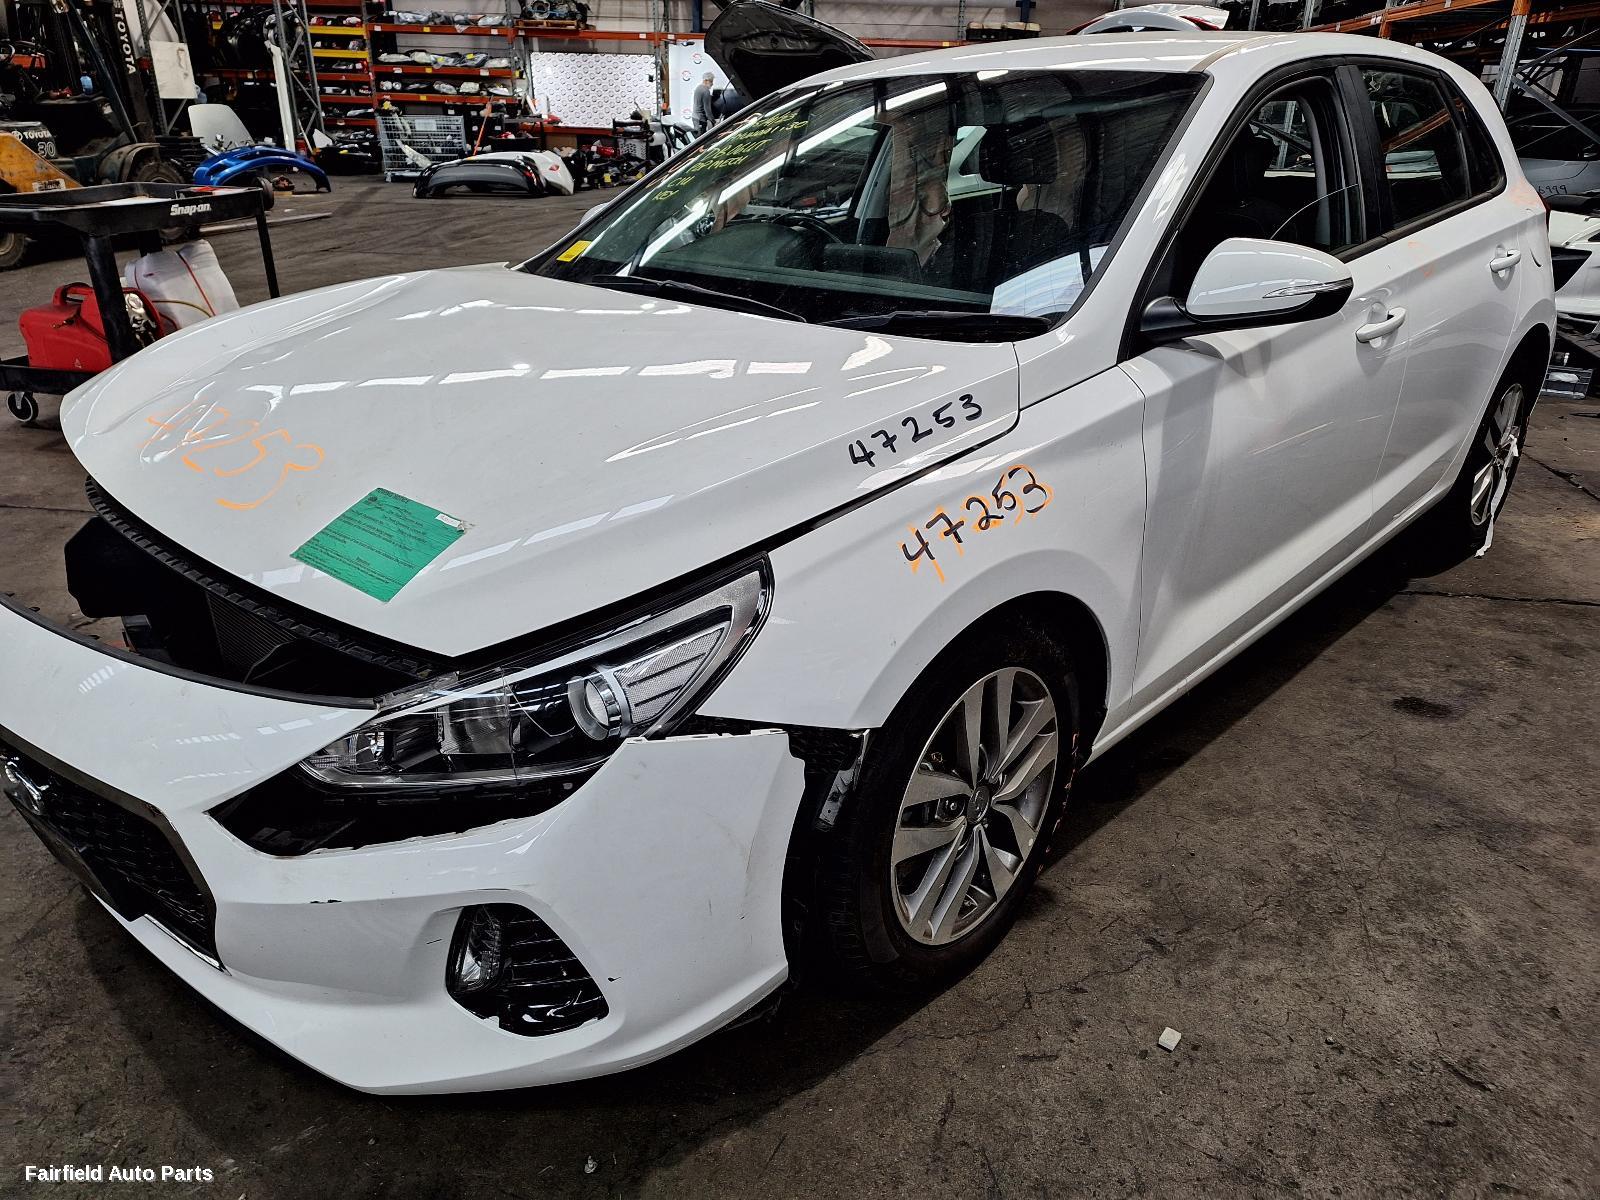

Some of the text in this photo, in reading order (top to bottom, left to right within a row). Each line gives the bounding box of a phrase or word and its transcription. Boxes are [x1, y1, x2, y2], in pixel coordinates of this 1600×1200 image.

[114, 11, 136, 74] TOYOTA
[22, 130, 52, 139] TOYOTA
[849, 393, 983, 467] 47253
[900, 465, 1052, 572] 47253
